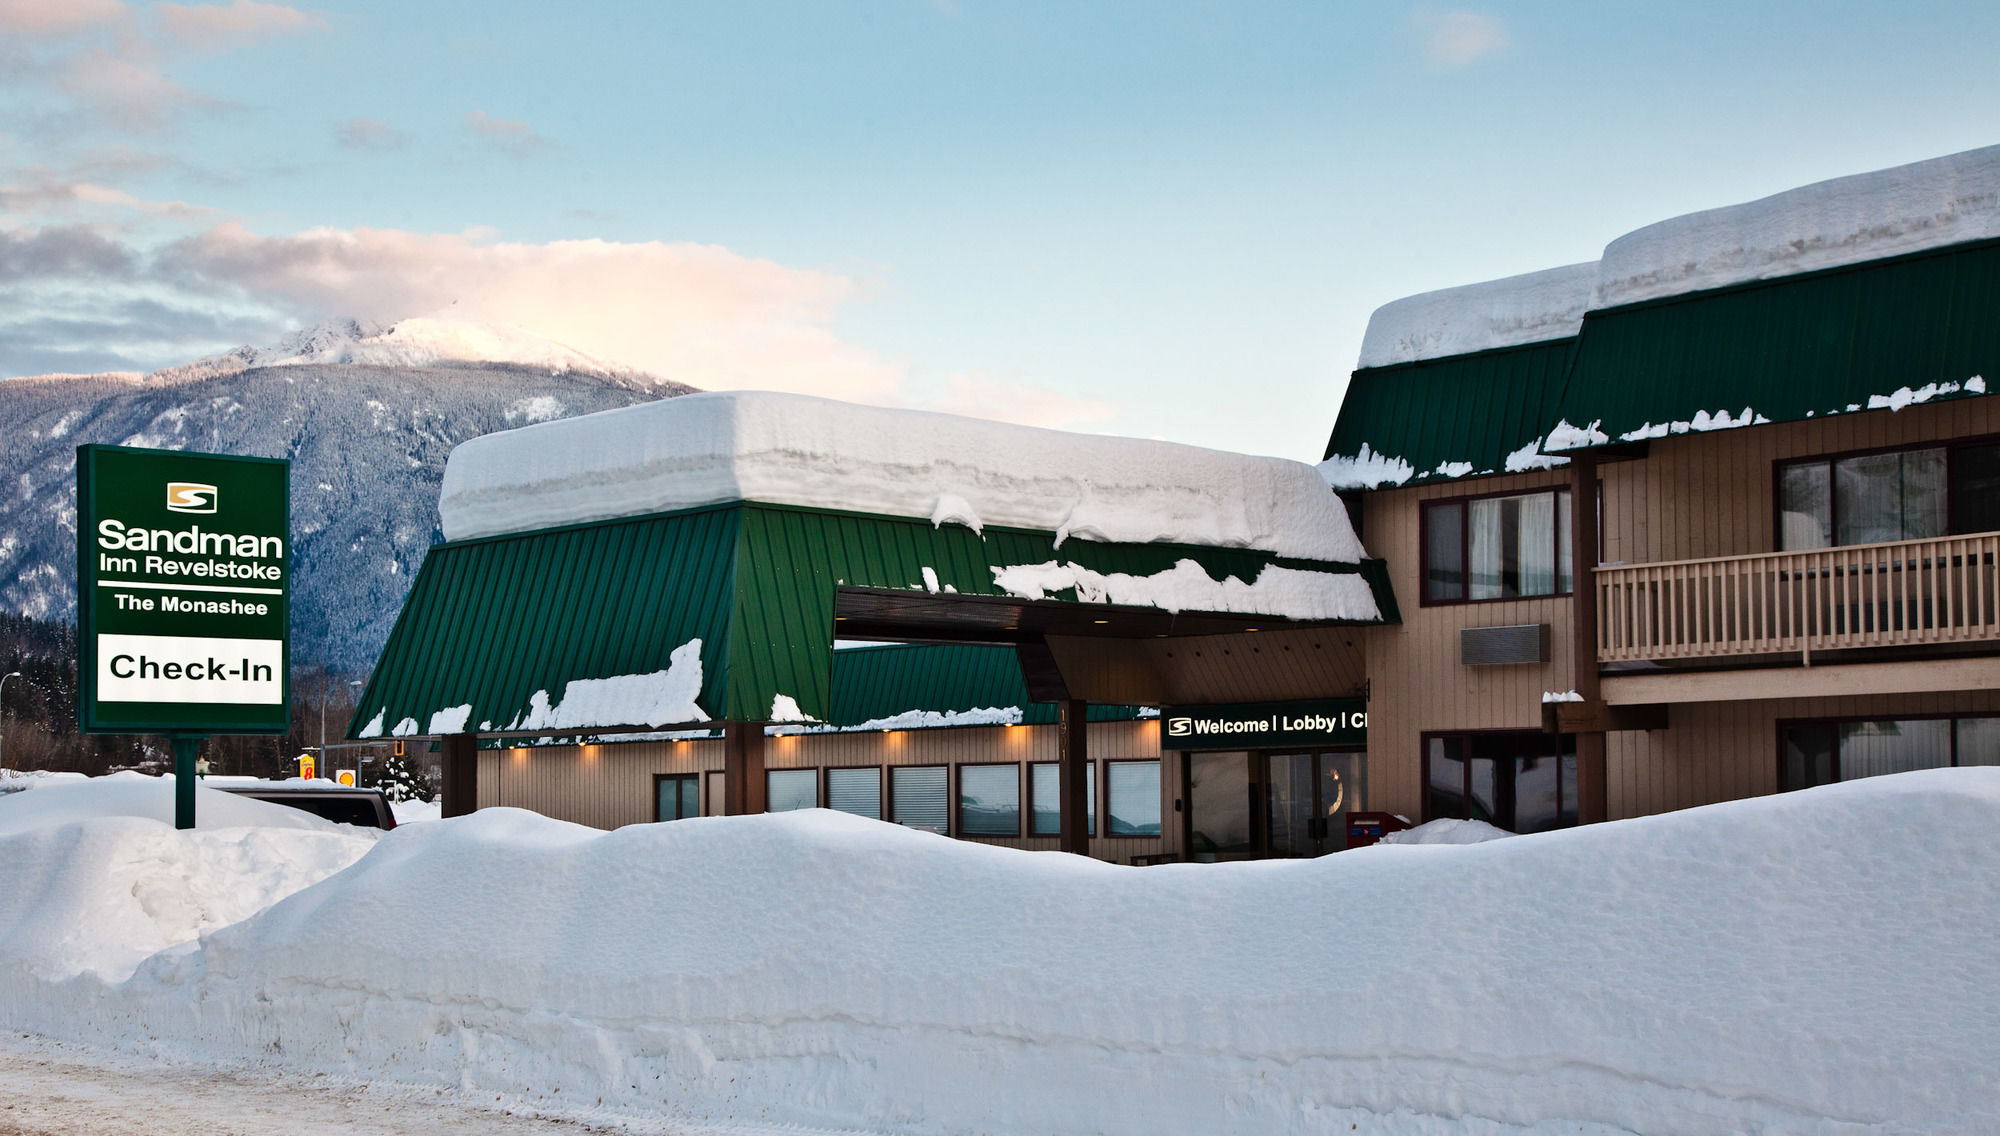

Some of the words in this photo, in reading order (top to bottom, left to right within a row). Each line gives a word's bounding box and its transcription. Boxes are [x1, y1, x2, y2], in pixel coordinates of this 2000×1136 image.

[98, 519, 283, 559] Sandman
[100, 553, 137, 573] Inn
[145, 555, 281, 580] Revelstoke
[114, 594, 155, 610] The
[161, 596, 268, 615] Monashee
[110, 654, 272, 682] Check-In
[1194, 719, 1269, 734] Welcome
[1283, 714, 1336, 733] Lobby
